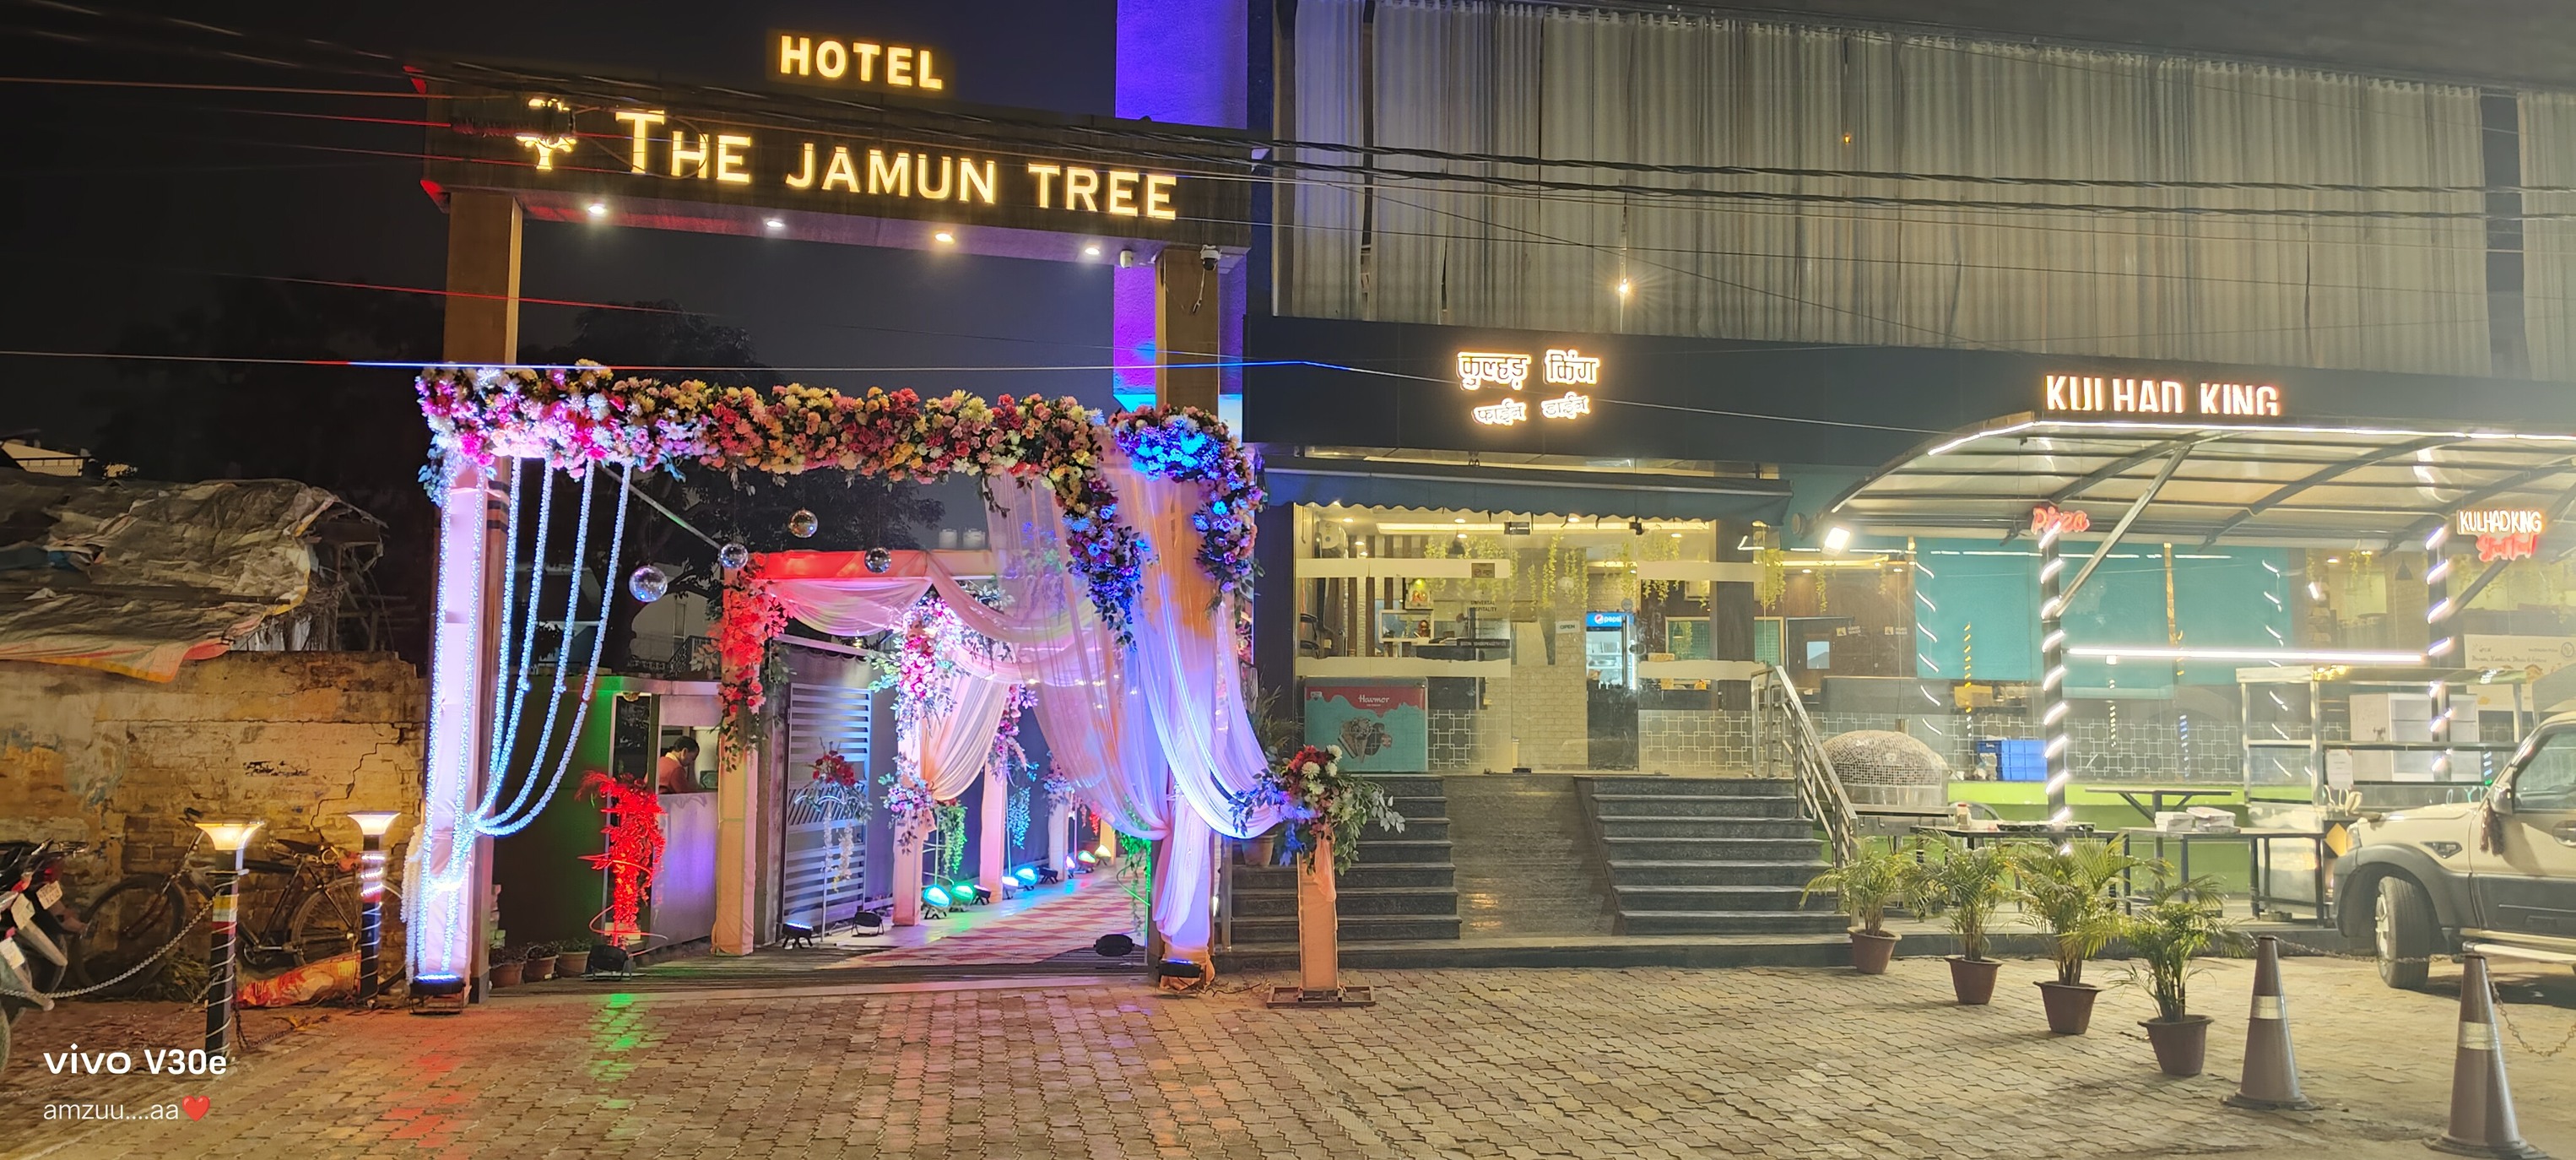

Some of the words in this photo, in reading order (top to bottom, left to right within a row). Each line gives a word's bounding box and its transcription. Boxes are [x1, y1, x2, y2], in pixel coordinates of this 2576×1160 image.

[780, 35, 942, 89] HOTEL
[615, 109, 752, 183] THE
[785, 143, 995, 204] JAMUN
[1027, 162, 1177, 220] TREE
[1545, 350, 1599, 383] किंग
[2200, 382, 2279, 416] KING
[2459, 510, 2510, 534] KULHAD
[2511, 510, 2541, 534] KING
